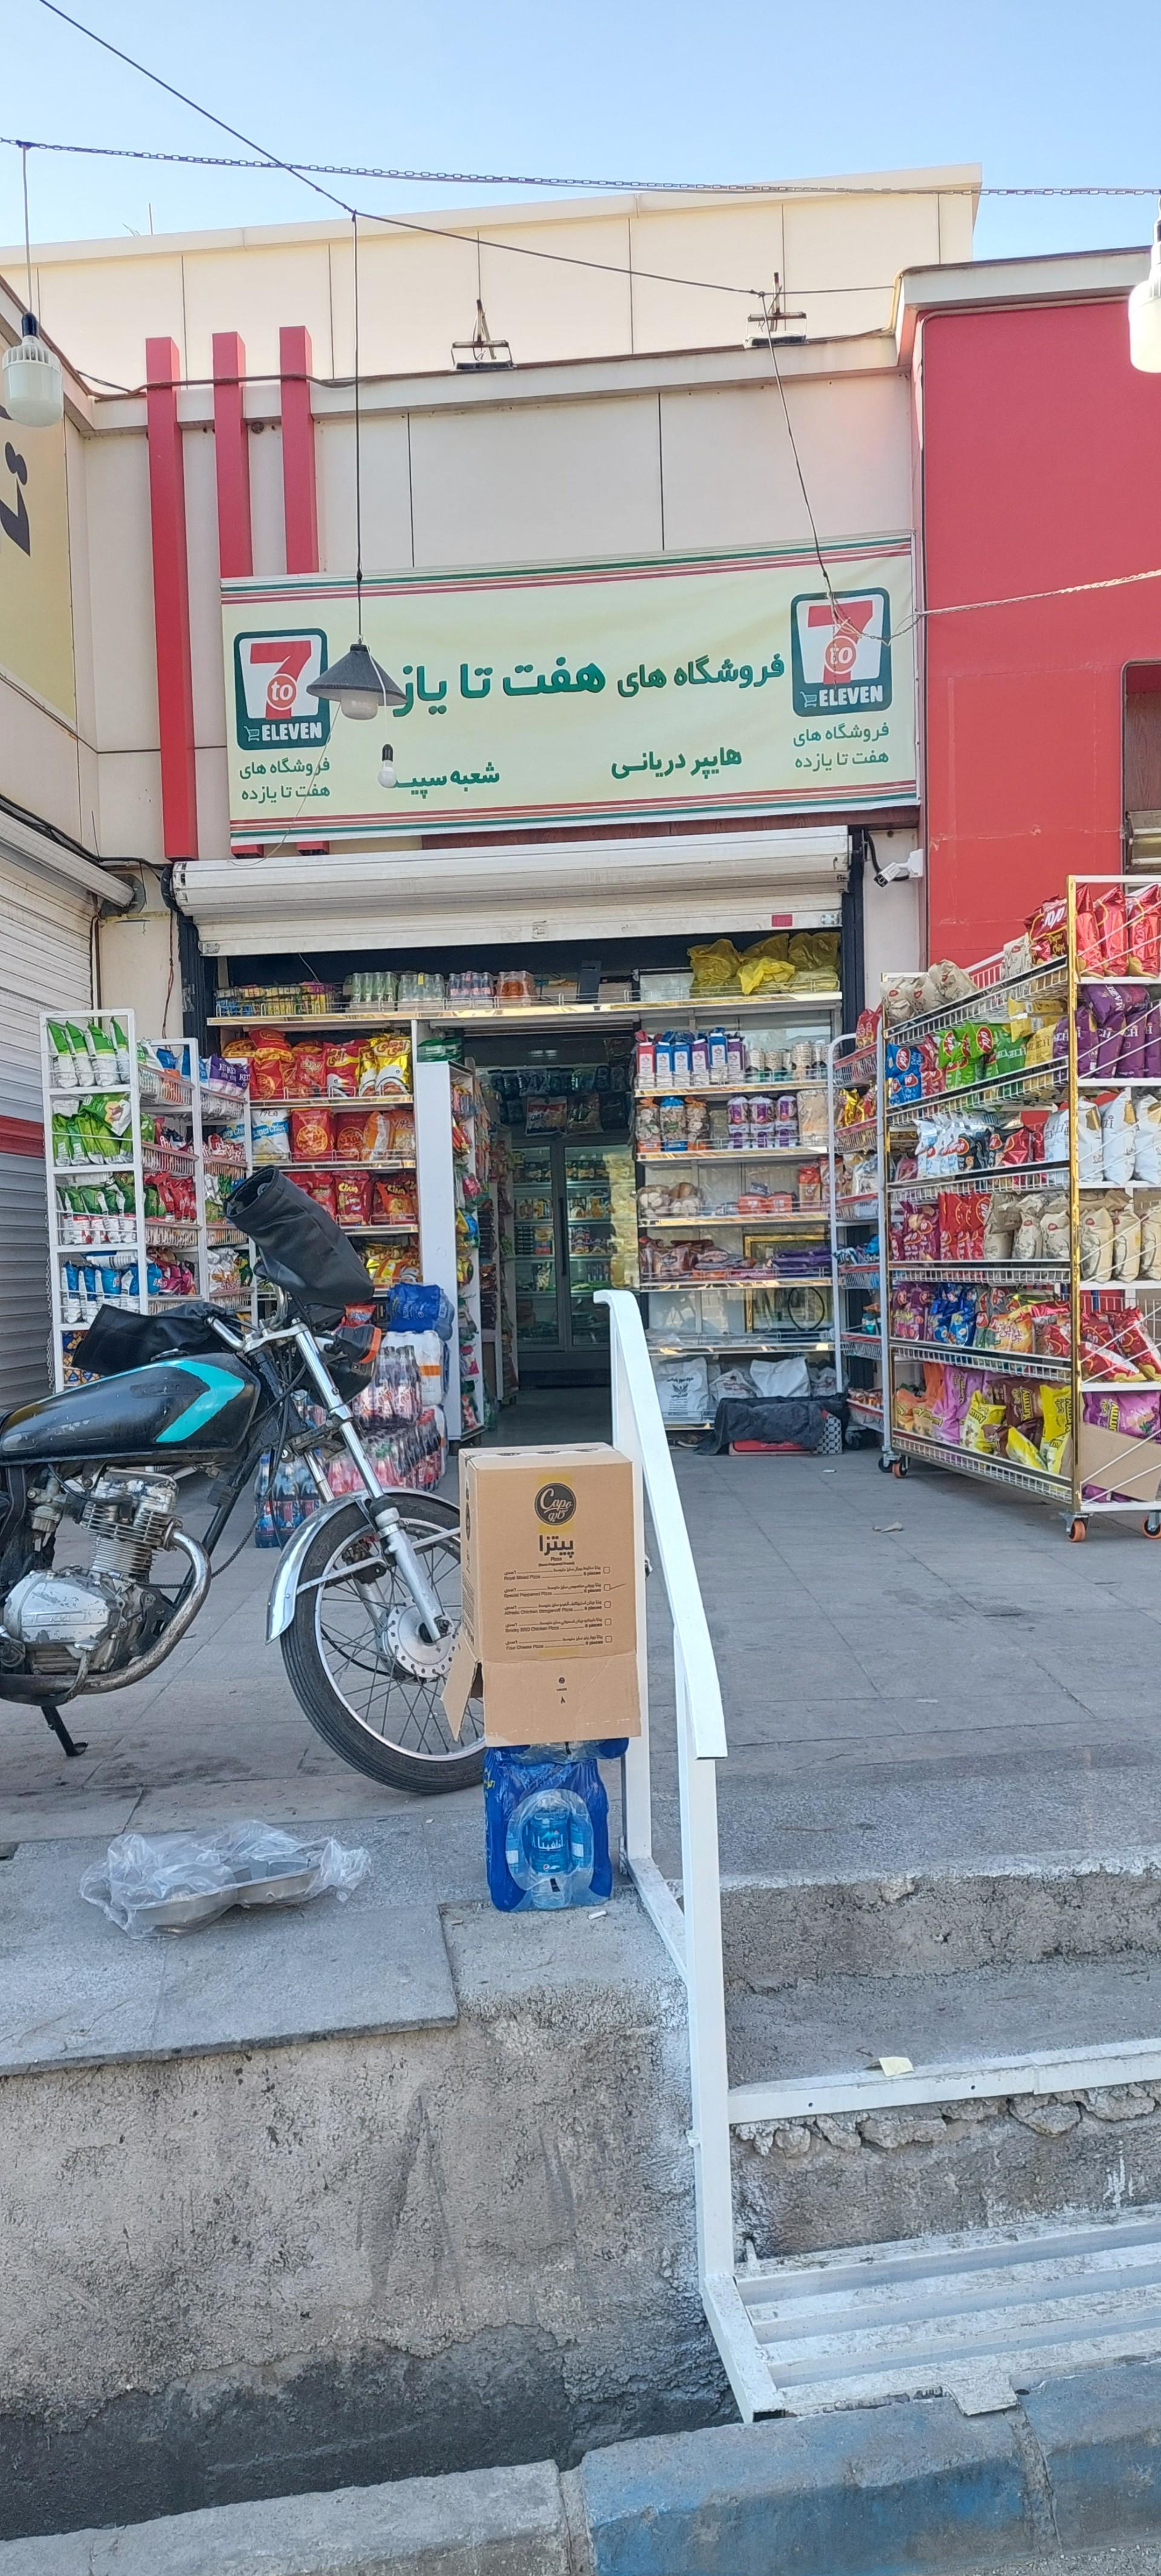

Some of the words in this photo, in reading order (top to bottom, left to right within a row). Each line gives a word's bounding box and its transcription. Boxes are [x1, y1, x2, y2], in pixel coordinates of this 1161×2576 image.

[831, 643, 853, 663] to
[250, 640, 311, 720] 7
[460, 663, 493, 698] تا
[502, 656, 605, 696] هفت
[617, 663, 667, 697] های
[674, 653, 785, 688] فروشگاه
[270, 683, 293, 701] to
[392, 664, 448, 718] یاز
[819, 685, 883, 707] ELEVEN
[262, 722, 322, 741] ELEVEN
[793, 727, 821, 747] های
[825, 722, 889, 741] فروشگاه
[270, 757, 330, 775] فروشگاه
[611, 750, 686, 779] دریانی
[691, 746, 742, 780] هایپر
[795, 754, 833, 773] یازده
[837, 752, 848, 767] تا
[853, 750, 889, 766] هفت
[239, 762, 266, 779] های
[450, 761, 500, 792] شعبه
[241, 787, 278, 804] یازده
[281, 785, 291, 798] تا
[295, 784, 330, 798] هفت
[394, 772, 448, 799] سپی
[1022, 1389, 1032, 1421] Yummy
[1108, 1402, 1119, 1432] ummy
[540, 1488, 573, 1511] Capo
[539, 1535, 574, 1558] پیتزا
